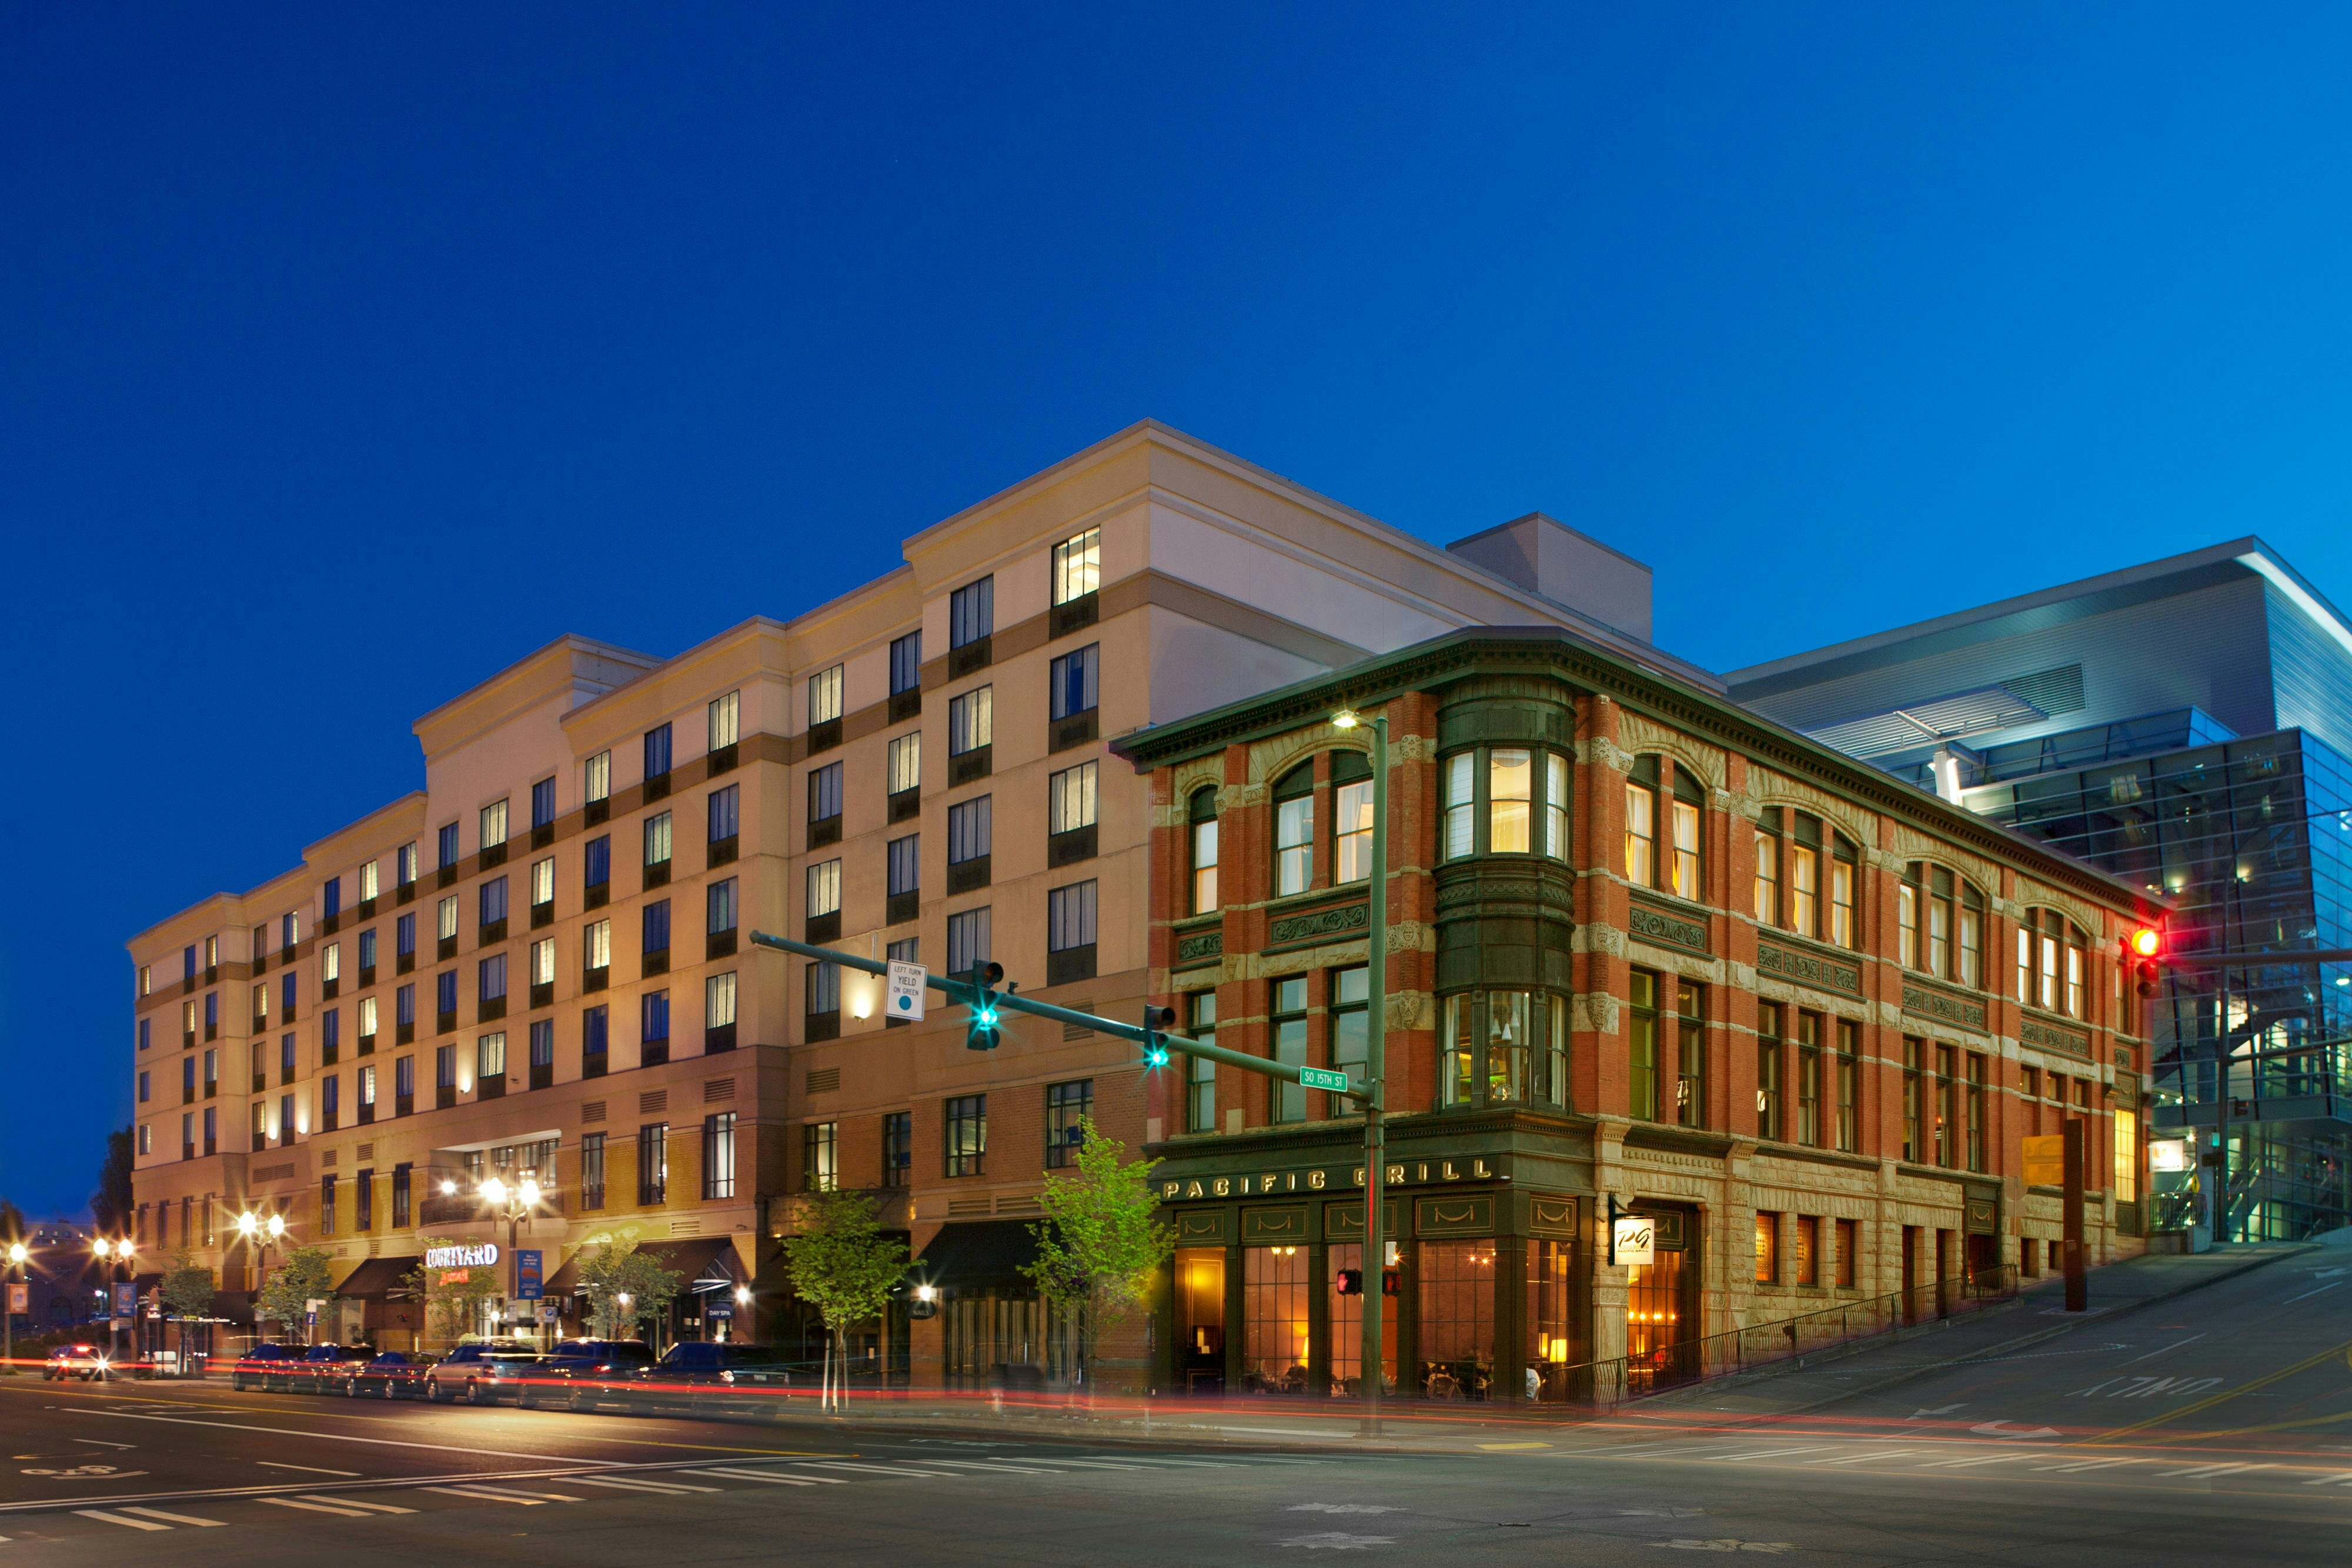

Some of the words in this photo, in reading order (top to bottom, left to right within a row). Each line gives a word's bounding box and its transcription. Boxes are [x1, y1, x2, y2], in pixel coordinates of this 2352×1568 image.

[908, 968, 921, 976] TURN
[898, 975, 916, 986] YIELD
[903, 988, 918, 996] GREEN
[1305, 1071, 1314, 1082] SO
[1317, 1074, 1332, 1085] 15TH
[1335, 1076, 1342, 1086] ST
[1162, 1171, 1325, 1199] PACIFIC
[1353, 1159, 1492, 1185] GRILL
[426, 1243, 499, 1268] COURTYARD
[2064, 1376, 2224, 1398] ONLY
